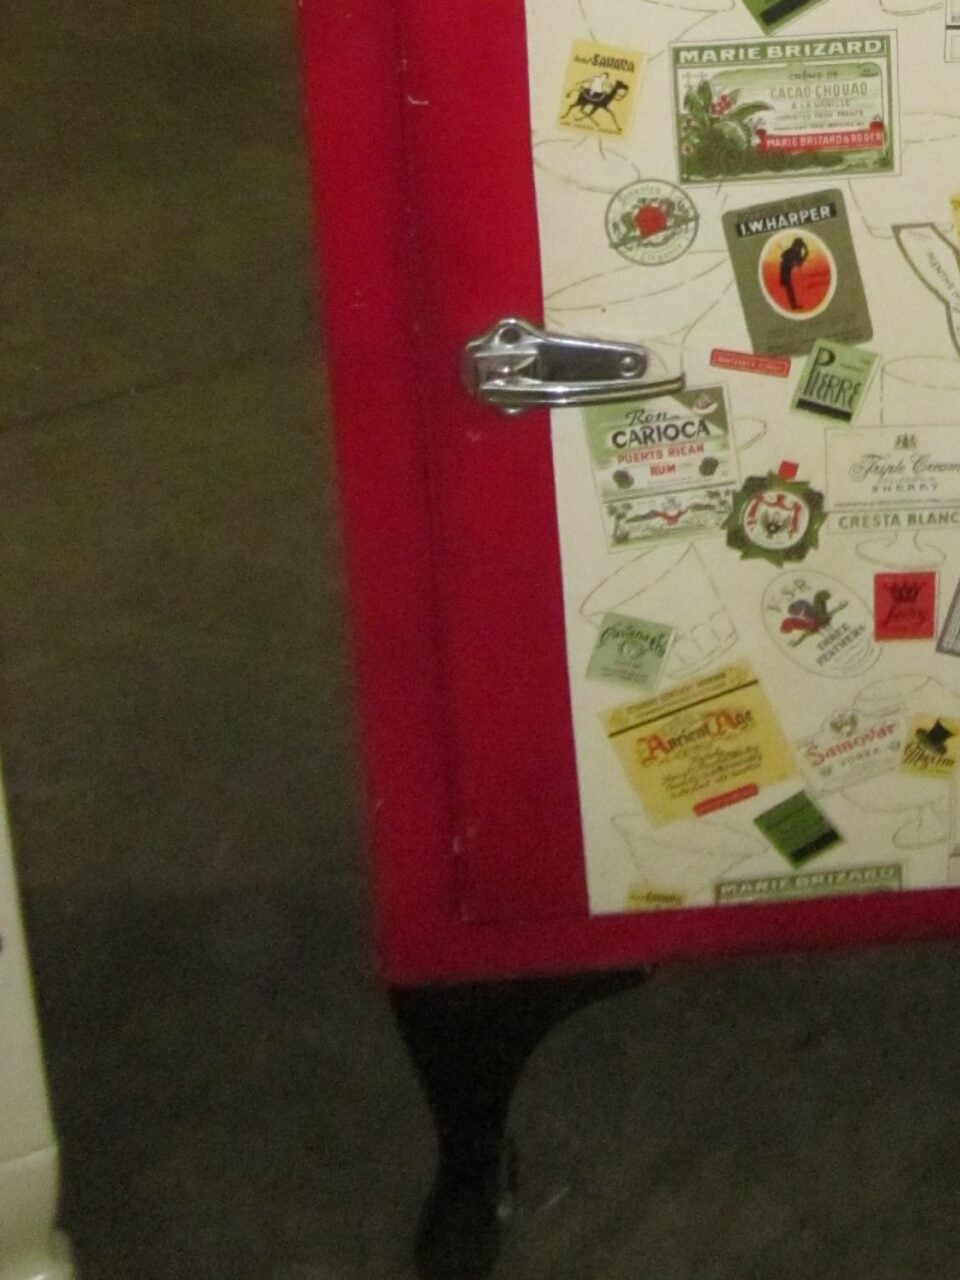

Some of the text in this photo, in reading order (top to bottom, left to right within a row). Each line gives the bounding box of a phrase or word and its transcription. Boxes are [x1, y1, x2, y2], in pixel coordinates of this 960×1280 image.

[679, 40, 882, 64] MARIE BRIZARD
[803, 347, 862, 402] PIERRE
[624, 409, 681, 427] Ron
[611, 419, 711, 449] CARIOCA
[617, 443, 705, 465] PUERTO RICAN
[649, 464, 677, 477] RUM
[849, 453, 906, 483] Triple
[871, 483, 939, 493] SHERRY
[838, 514, 901, 530] CRESTA
[636, 707, 755, 767] Ancient Age
[807, 723, 897, 767] Samovar
[719, 876, 788, 896] MARIE
